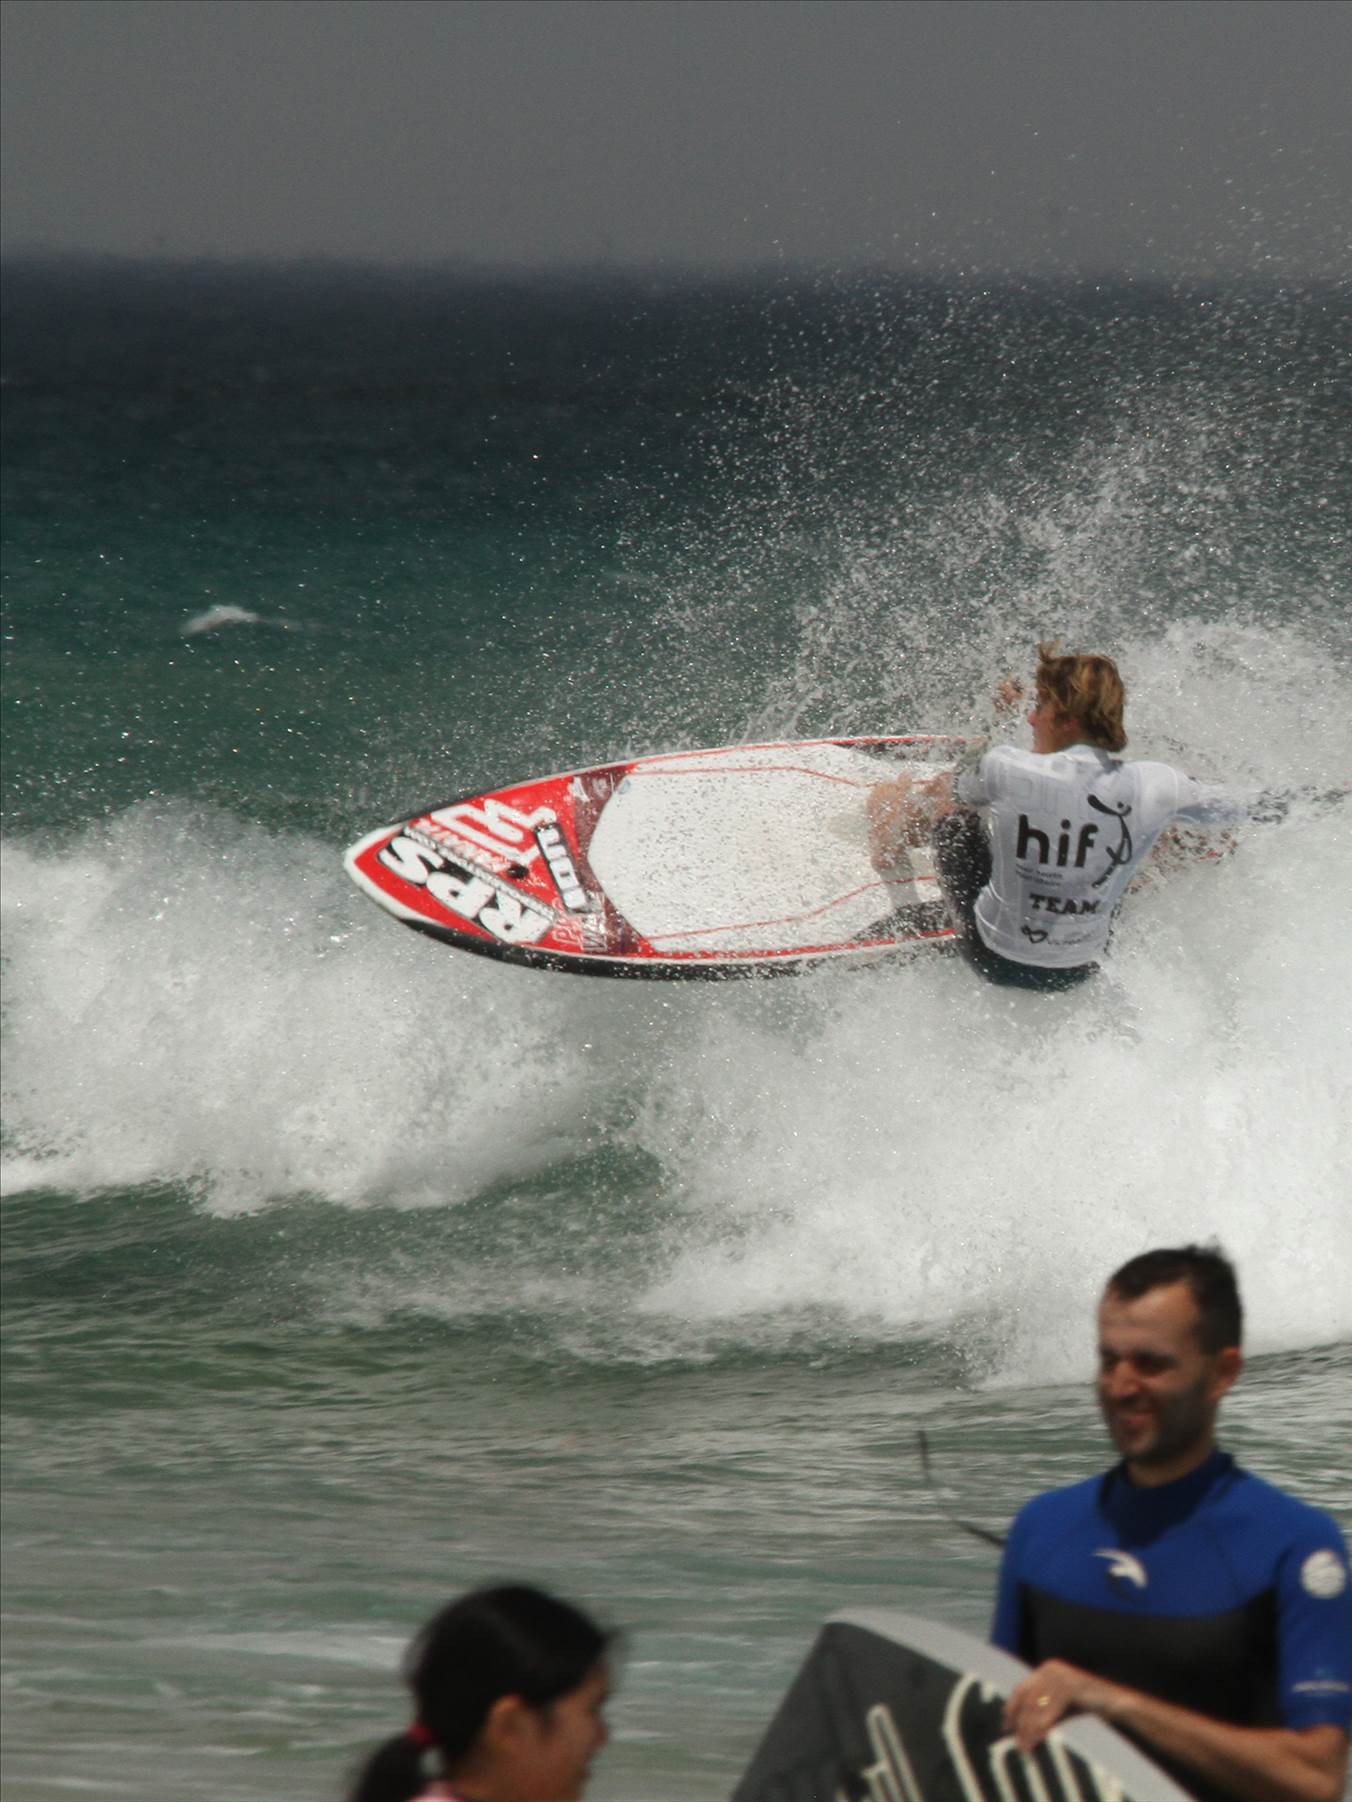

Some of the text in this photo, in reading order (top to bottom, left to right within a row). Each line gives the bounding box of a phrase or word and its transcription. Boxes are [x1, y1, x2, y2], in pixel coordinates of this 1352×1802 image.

[1016, 814, 1098, 867] hif
[378, 836, 553, 943] RPS
[1030, 893, 1101, 914] TEAM
